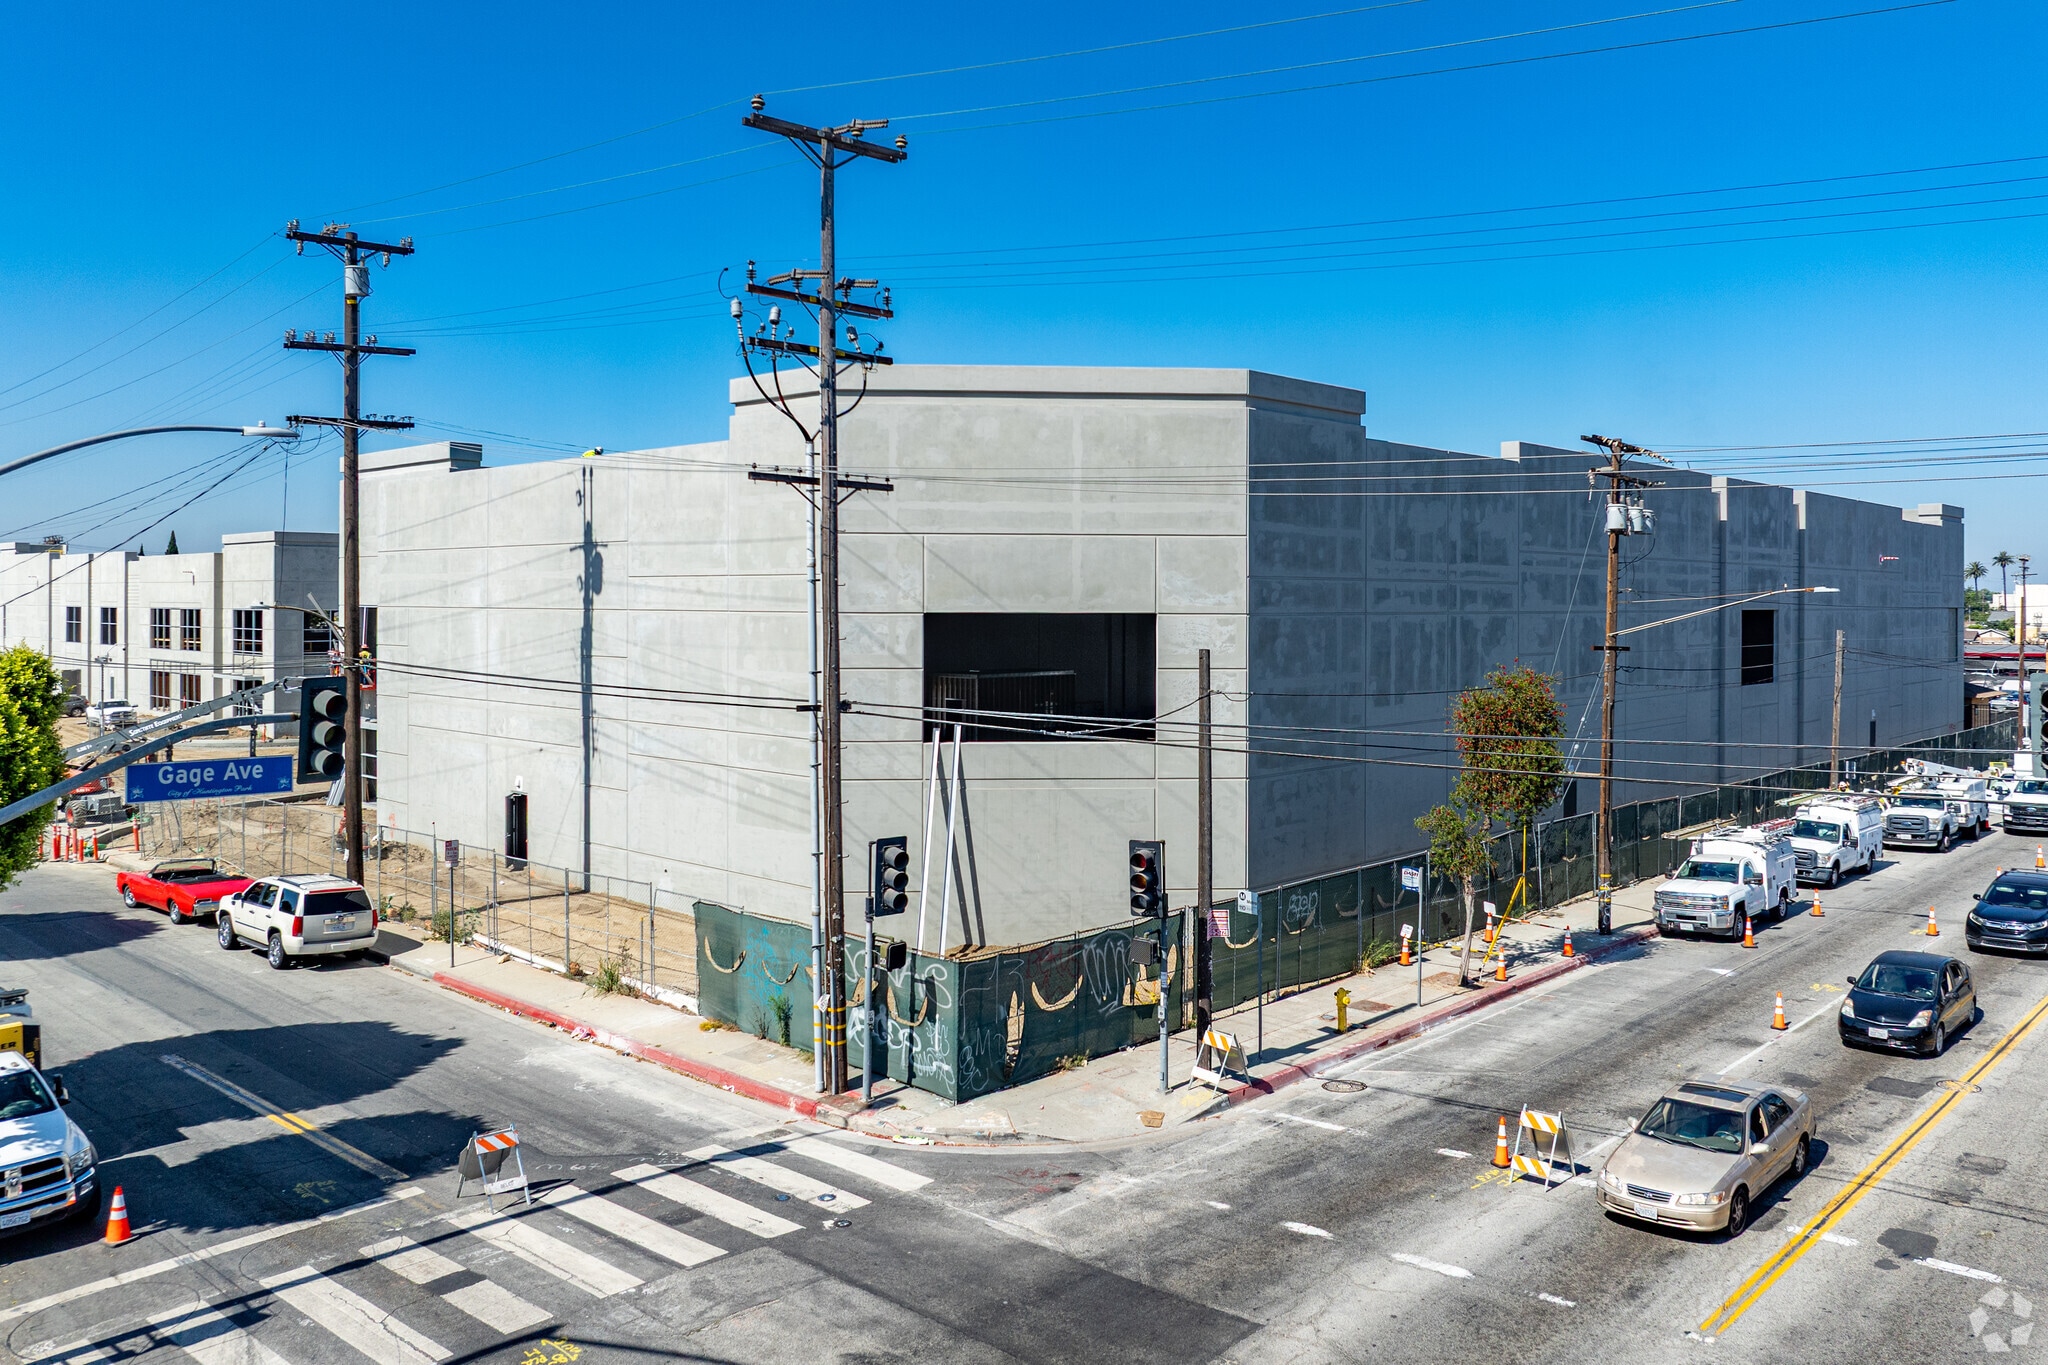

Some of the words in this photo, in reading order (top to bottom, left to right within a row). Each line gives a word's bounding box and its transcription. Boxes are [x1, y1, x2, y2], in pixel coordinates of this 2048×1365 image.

[158, 765, 215, 787] Gage
[223, 761, 264, 781] Ave
[167, 789, 181, 797] City
[182, 788, 191, 798] of
[192, 787, 232, 796] Huntington
[234, 784, 253, 793] Park
